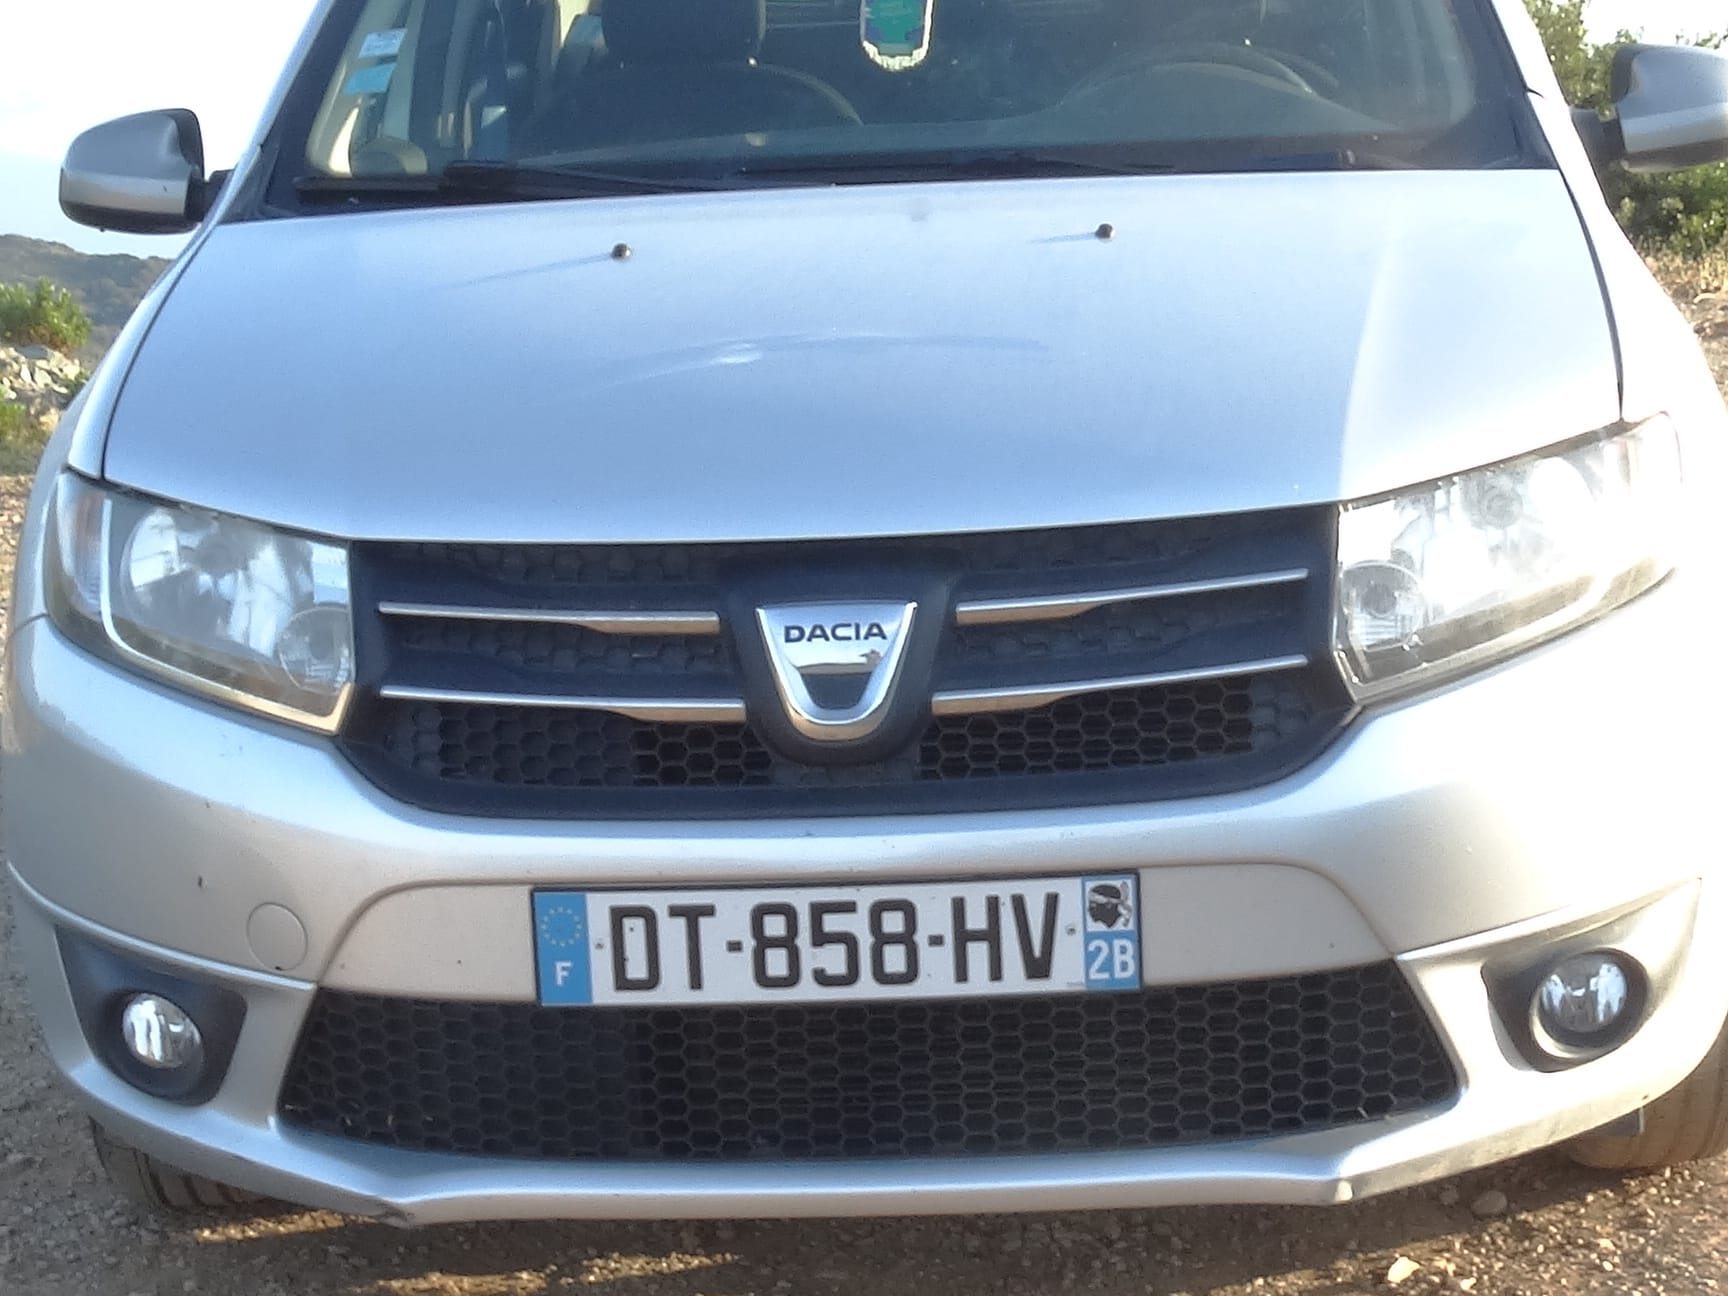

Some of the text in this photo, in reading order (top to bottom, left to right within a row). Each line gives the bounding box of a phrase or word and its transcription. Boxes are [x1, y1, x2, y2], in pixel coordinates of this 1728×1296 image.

[784, 622, 887, 643] DACIA
[610, 891, 1059, 991] DT-858-HV
[555, 961, 572, 986] F
[1088, 938, 1135, 980] 2B
